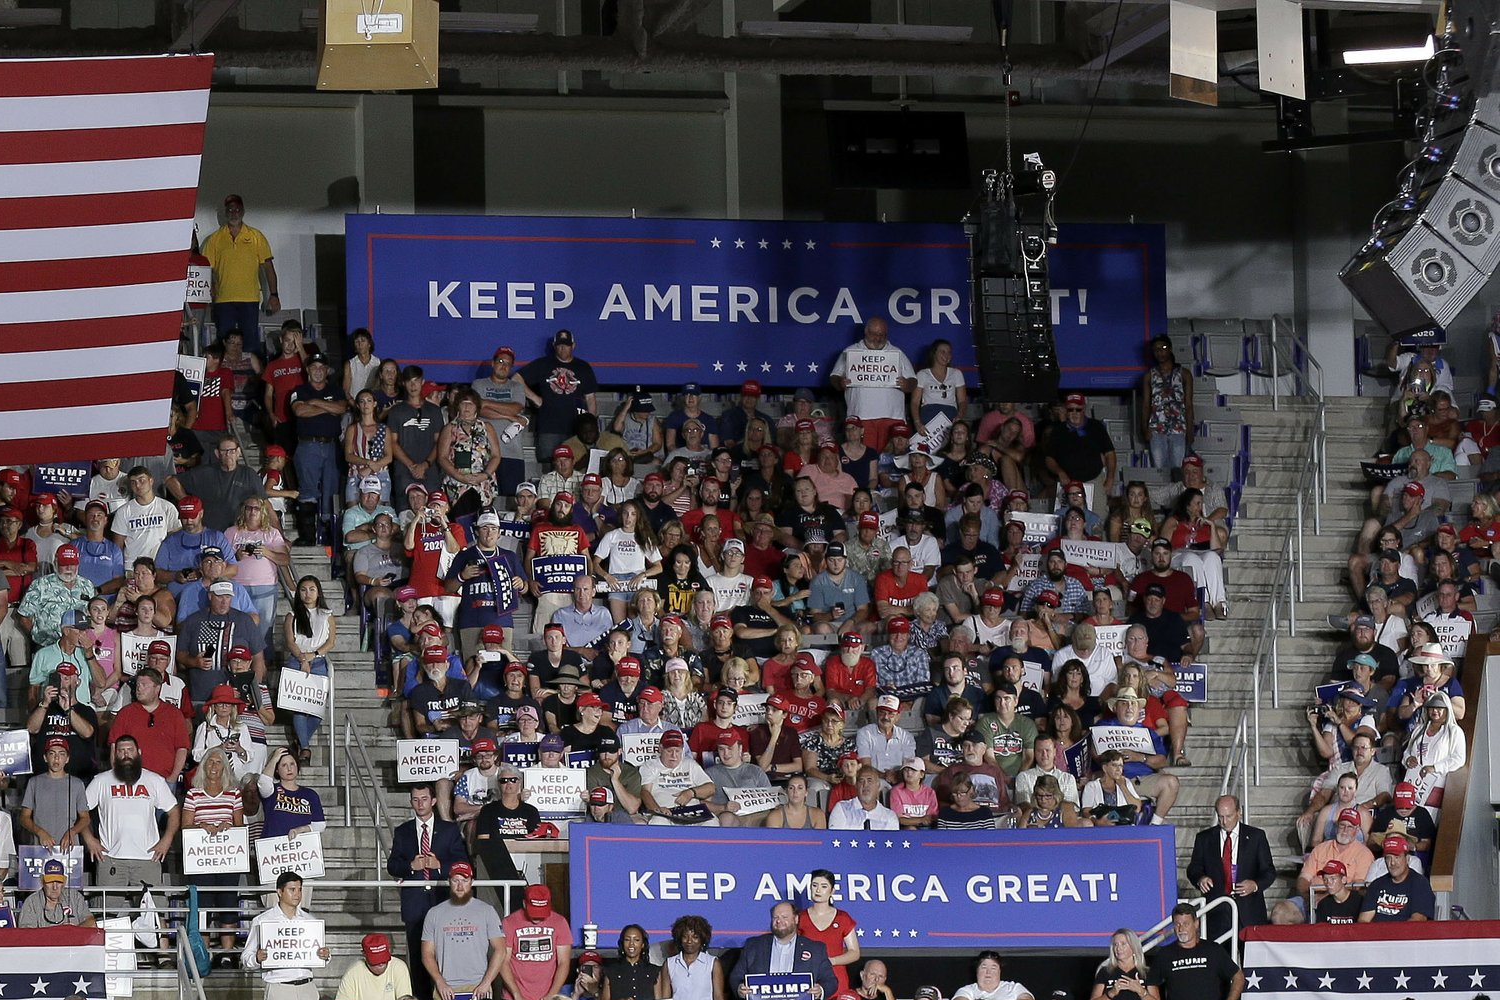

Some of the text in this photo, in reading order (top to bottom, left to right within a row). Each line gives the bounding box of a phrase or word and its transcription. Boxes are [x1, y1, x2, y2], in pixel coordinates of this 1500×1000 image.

[427, 281, 1088, 325] KEEP AMERICA GRT!
[862, 356, 885, 364] KEEP
[850, 365, 898, 373] AMERICA
[857, 374, 890, 382] GREAT!
[39, 467, 87, 475] TRUMP
[129, 517, 163, 529] TRUMP
[536, 564, 583, 572] TRUMP
[548, 575, 573, 583] 2020
[1097, 734, 1148, 745] AMERICA
[414, 745, 441, 754] KEEP
[402, 756, 454, 765] AMERICA
[410, 766, 446, 775] GREAT!
[542, 775, 568, 783] KEEP
[112, 784, 148, 795] HIA
[530, 785, 580, 795] AMERICA
[538, 796, 576, 805] GREAT!
[274, 802, 311, 814] ALUMNI
[203, 835, 230, 844] KEEP
[188, 845, 245, 855] AMERICA
[274, 841, 302, 852] KEEP
[196, 857, 236, 867] GREAT!
[262, 852, 319, 866] AMERICA
[272, 864, 312, 875] GREAT!
[629, 871, 1118, 903] KEEP AMERICA GREAT!
[278, 927, 304, 935] KEEP
[517, 927, 554, 938] KEEP IT
[265, 939, 320, 949] AMERICA
[272, 951, 312, 961] GREAT!
[515, 952, 552, 961] CLASSIC
[1172, 958, 1207, 967] TRUMP
[750, 983, 810, 994] TRUMP
